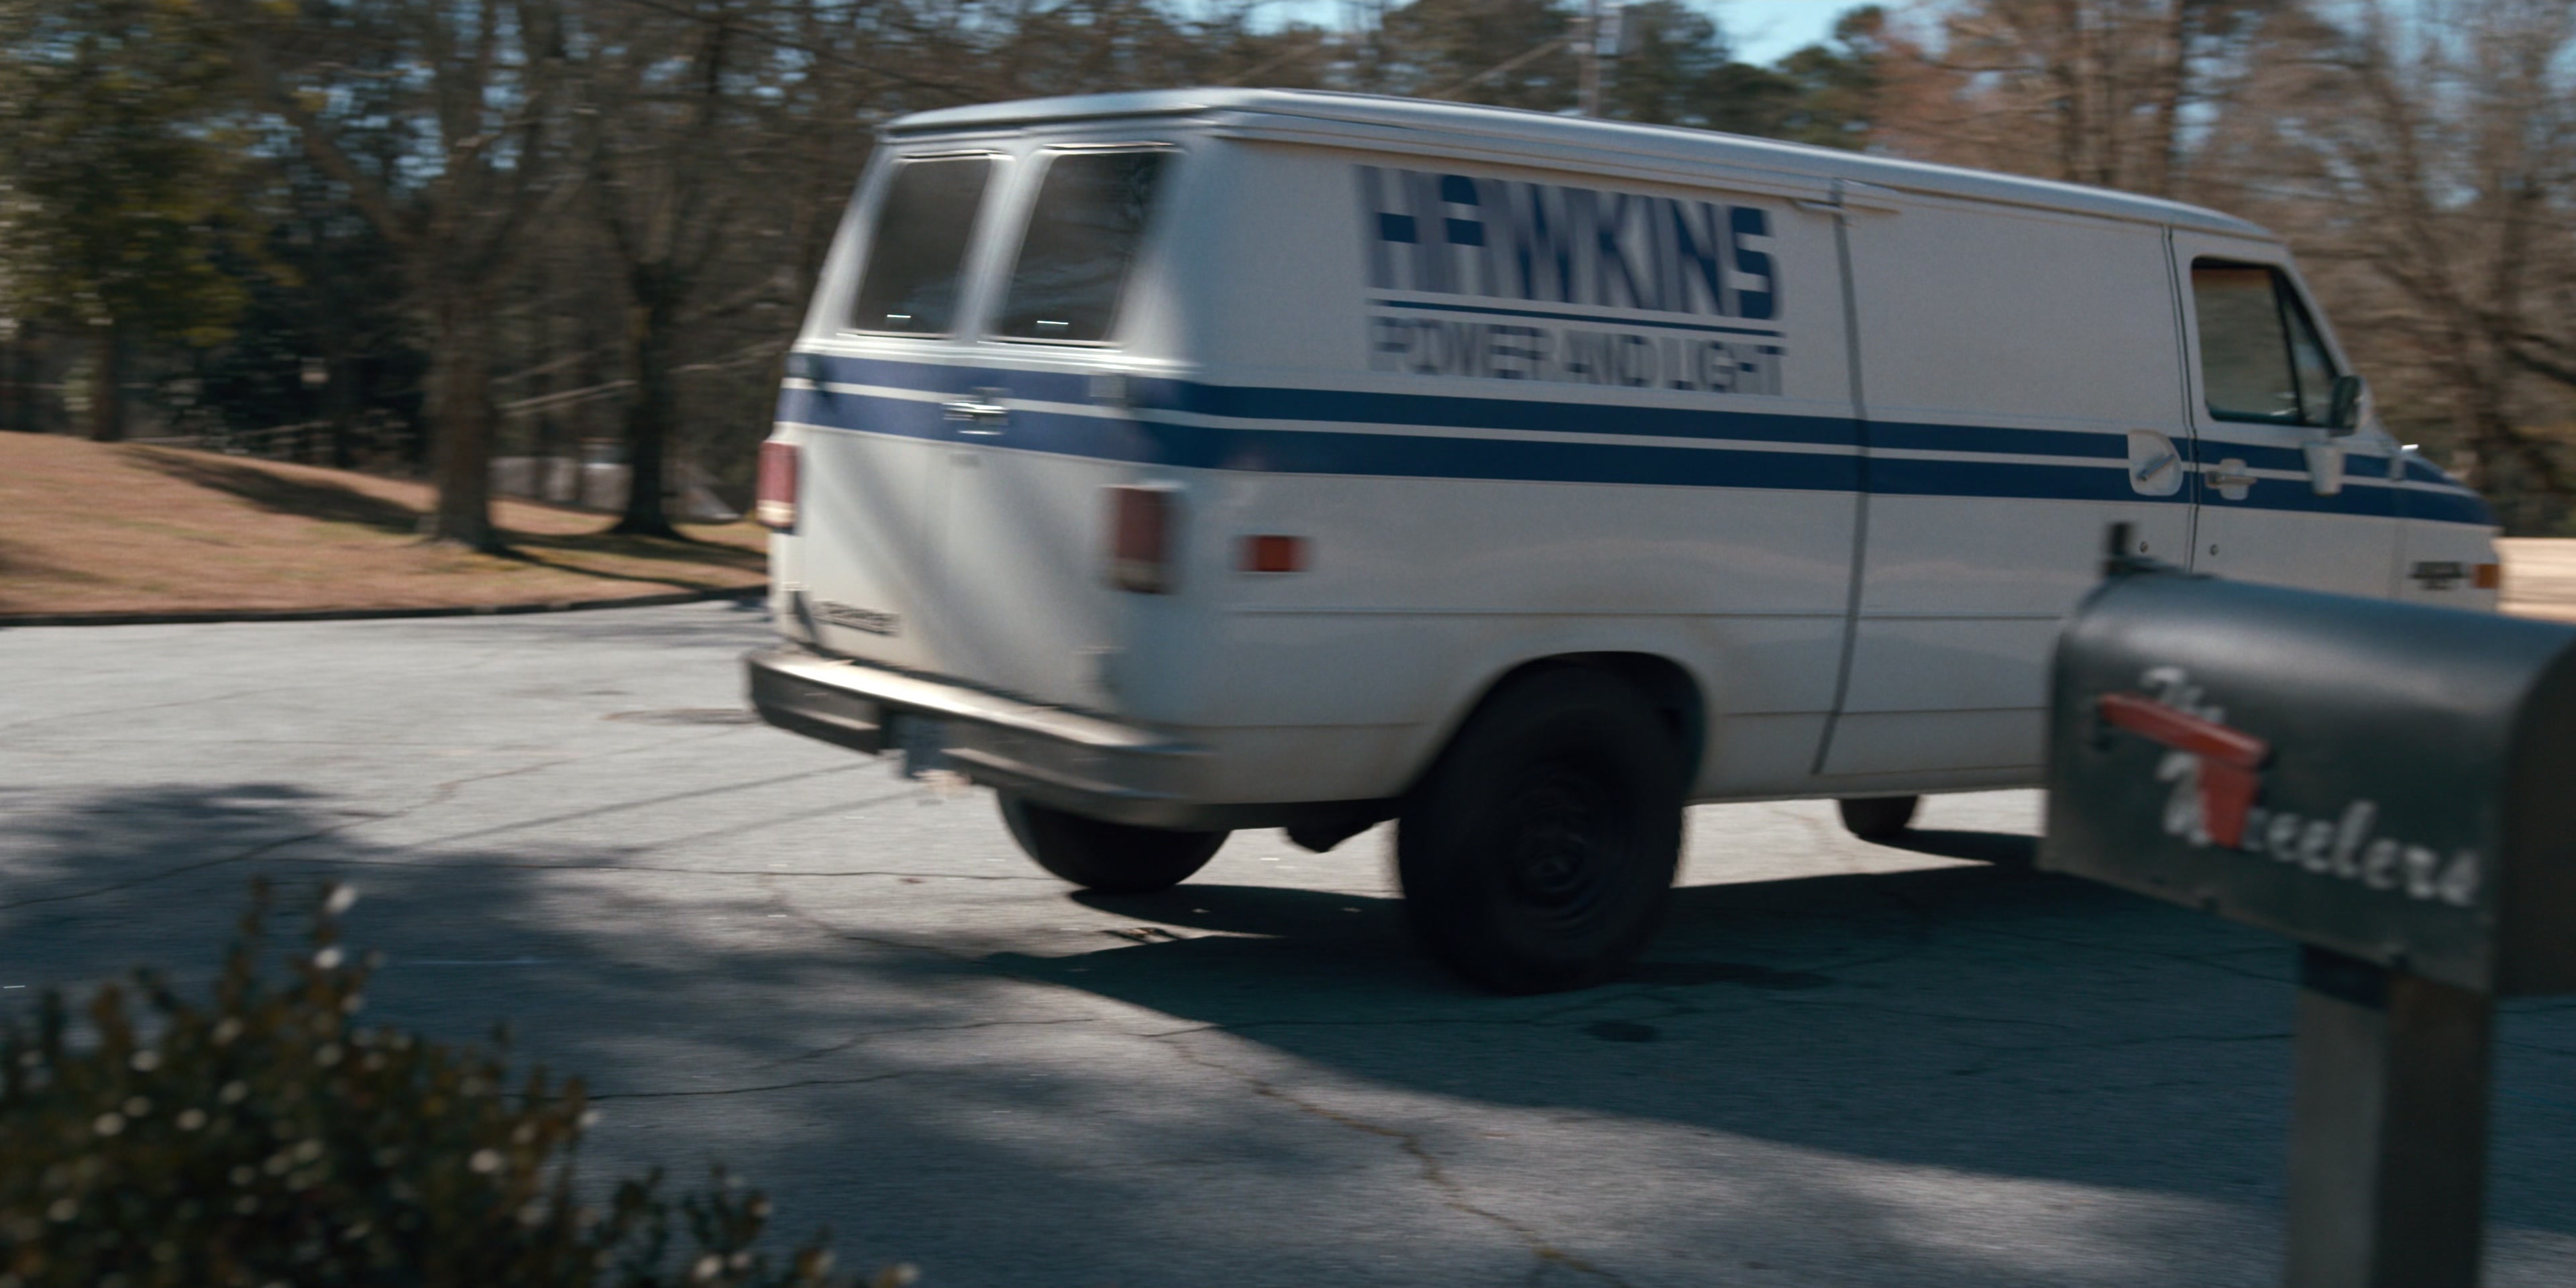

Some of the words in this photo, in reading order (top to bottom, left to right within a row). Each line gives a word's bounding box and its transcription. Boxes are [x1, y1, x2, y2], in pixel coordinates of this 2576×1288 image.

[1354, 164, 1782, 322] HAWKINS
[1367, 314, 1554, 381] POWER
[1560, 329, 1660, 389] AND
[1660, 334, 1787, 397] LIGHT
